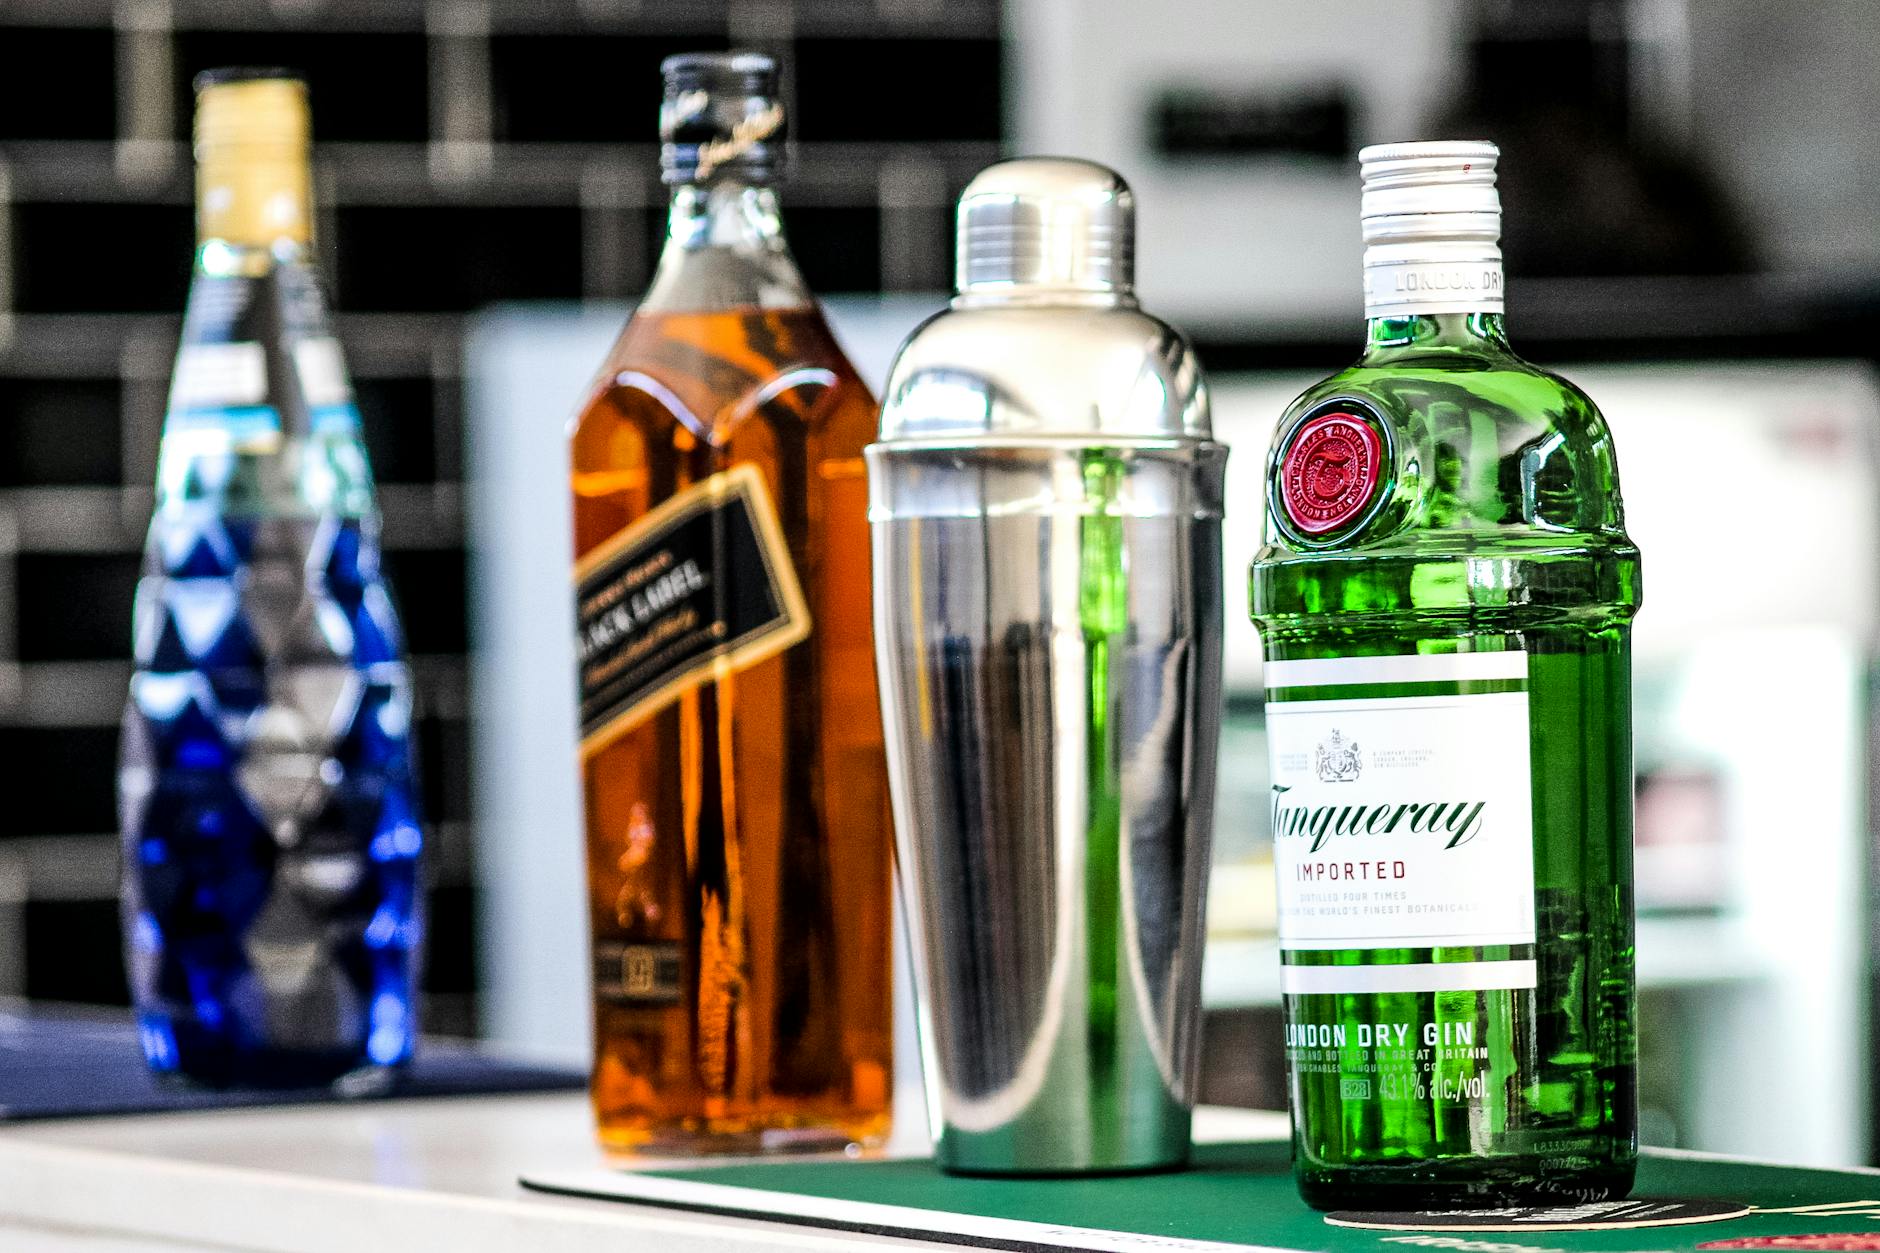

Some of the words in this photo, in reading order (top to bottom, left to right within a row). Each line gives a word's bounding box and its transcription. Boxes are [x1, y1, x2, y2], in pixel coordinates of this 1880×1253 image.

[1272, 784, 1486, 853] Tanqueray
[1296, 860, 1405, 881] IMPORTED
[1343, 892, 1368, 901] FOUR
[1373, 890, 1407, 901] TIMES
[1363, 905, 1401, 914] FINEST
[1285, 1023, 1346, 1047] LONDON
[1357, 1022, 1409, 1047] DRY
[1423, 1021, 1473, 1046] GIN
[1325, 1050, 1369, 1061] BOTTLED
[1392, 1049, 1431, 1061] GREAT
[1438, 1047, 1489, 1059] BRITAIN
[1379, 1071, 1425, 1100] 43.1%
[1429, 1070, 1491, 1102] alc./vol.
